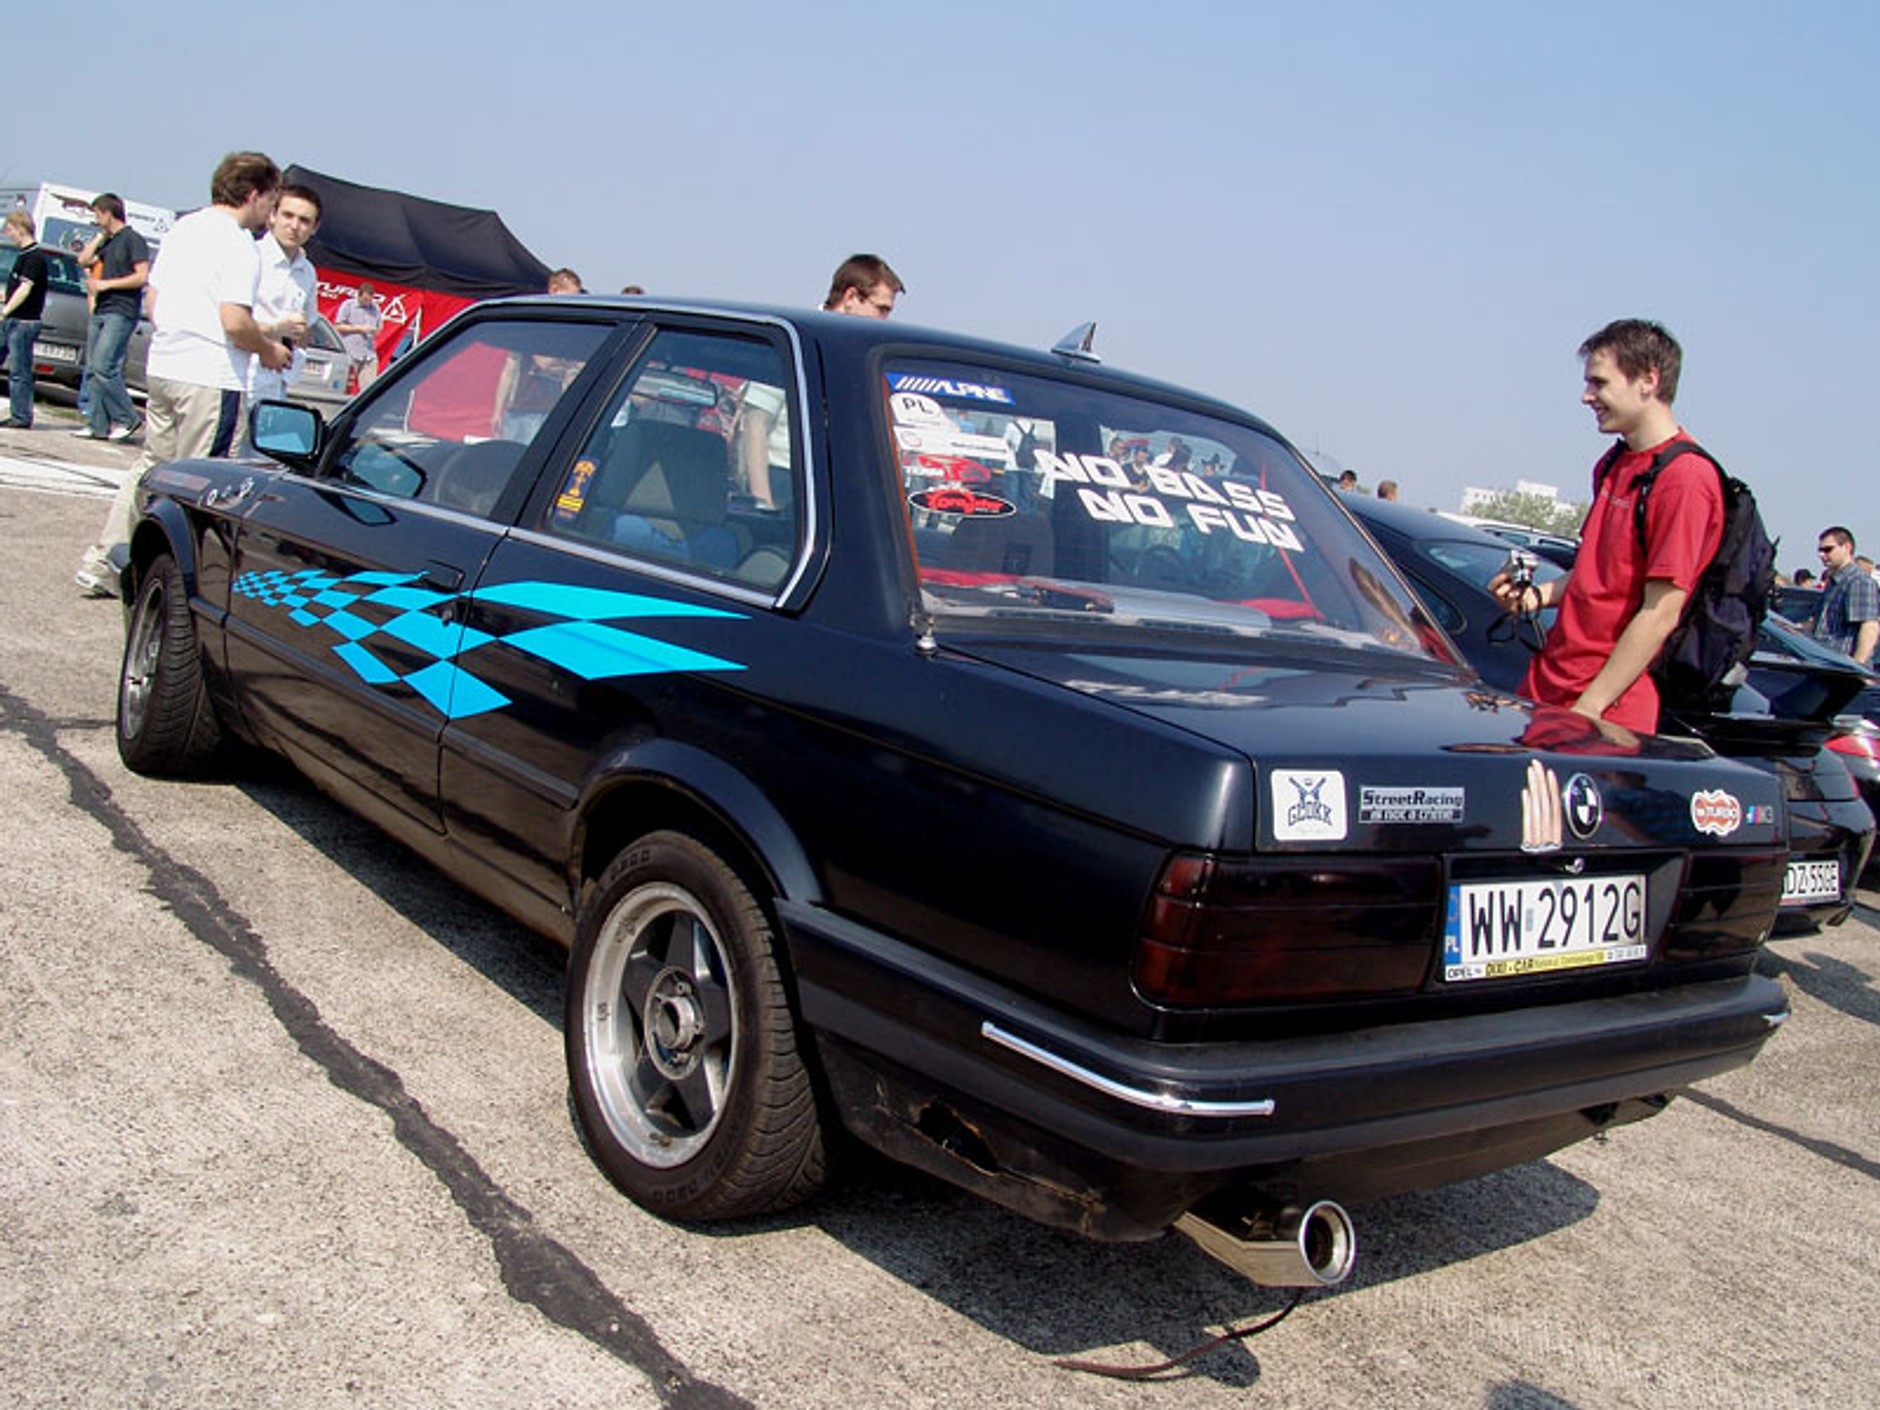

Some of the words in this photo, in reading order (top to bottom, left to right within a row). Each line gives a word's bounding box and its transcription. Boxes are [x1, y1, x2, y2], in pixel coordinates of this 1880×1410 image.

[902, 397, 934, 414] PL
[1034, 449, 1134, 488] NO
[1144, 464, 1296, 521] BASS
[1077, 488, 1174, 528] NO
[1186, 503, 1305, 552] FUN
[1362, 789, 1463, 808] StreetRacing
[1468, 888, 1523, 957] WW
[1536, 881, 1641, 949] 2912G
[1445, 935, 1458, 954] PL
[1447, 965, 1473, 980] OPEL
